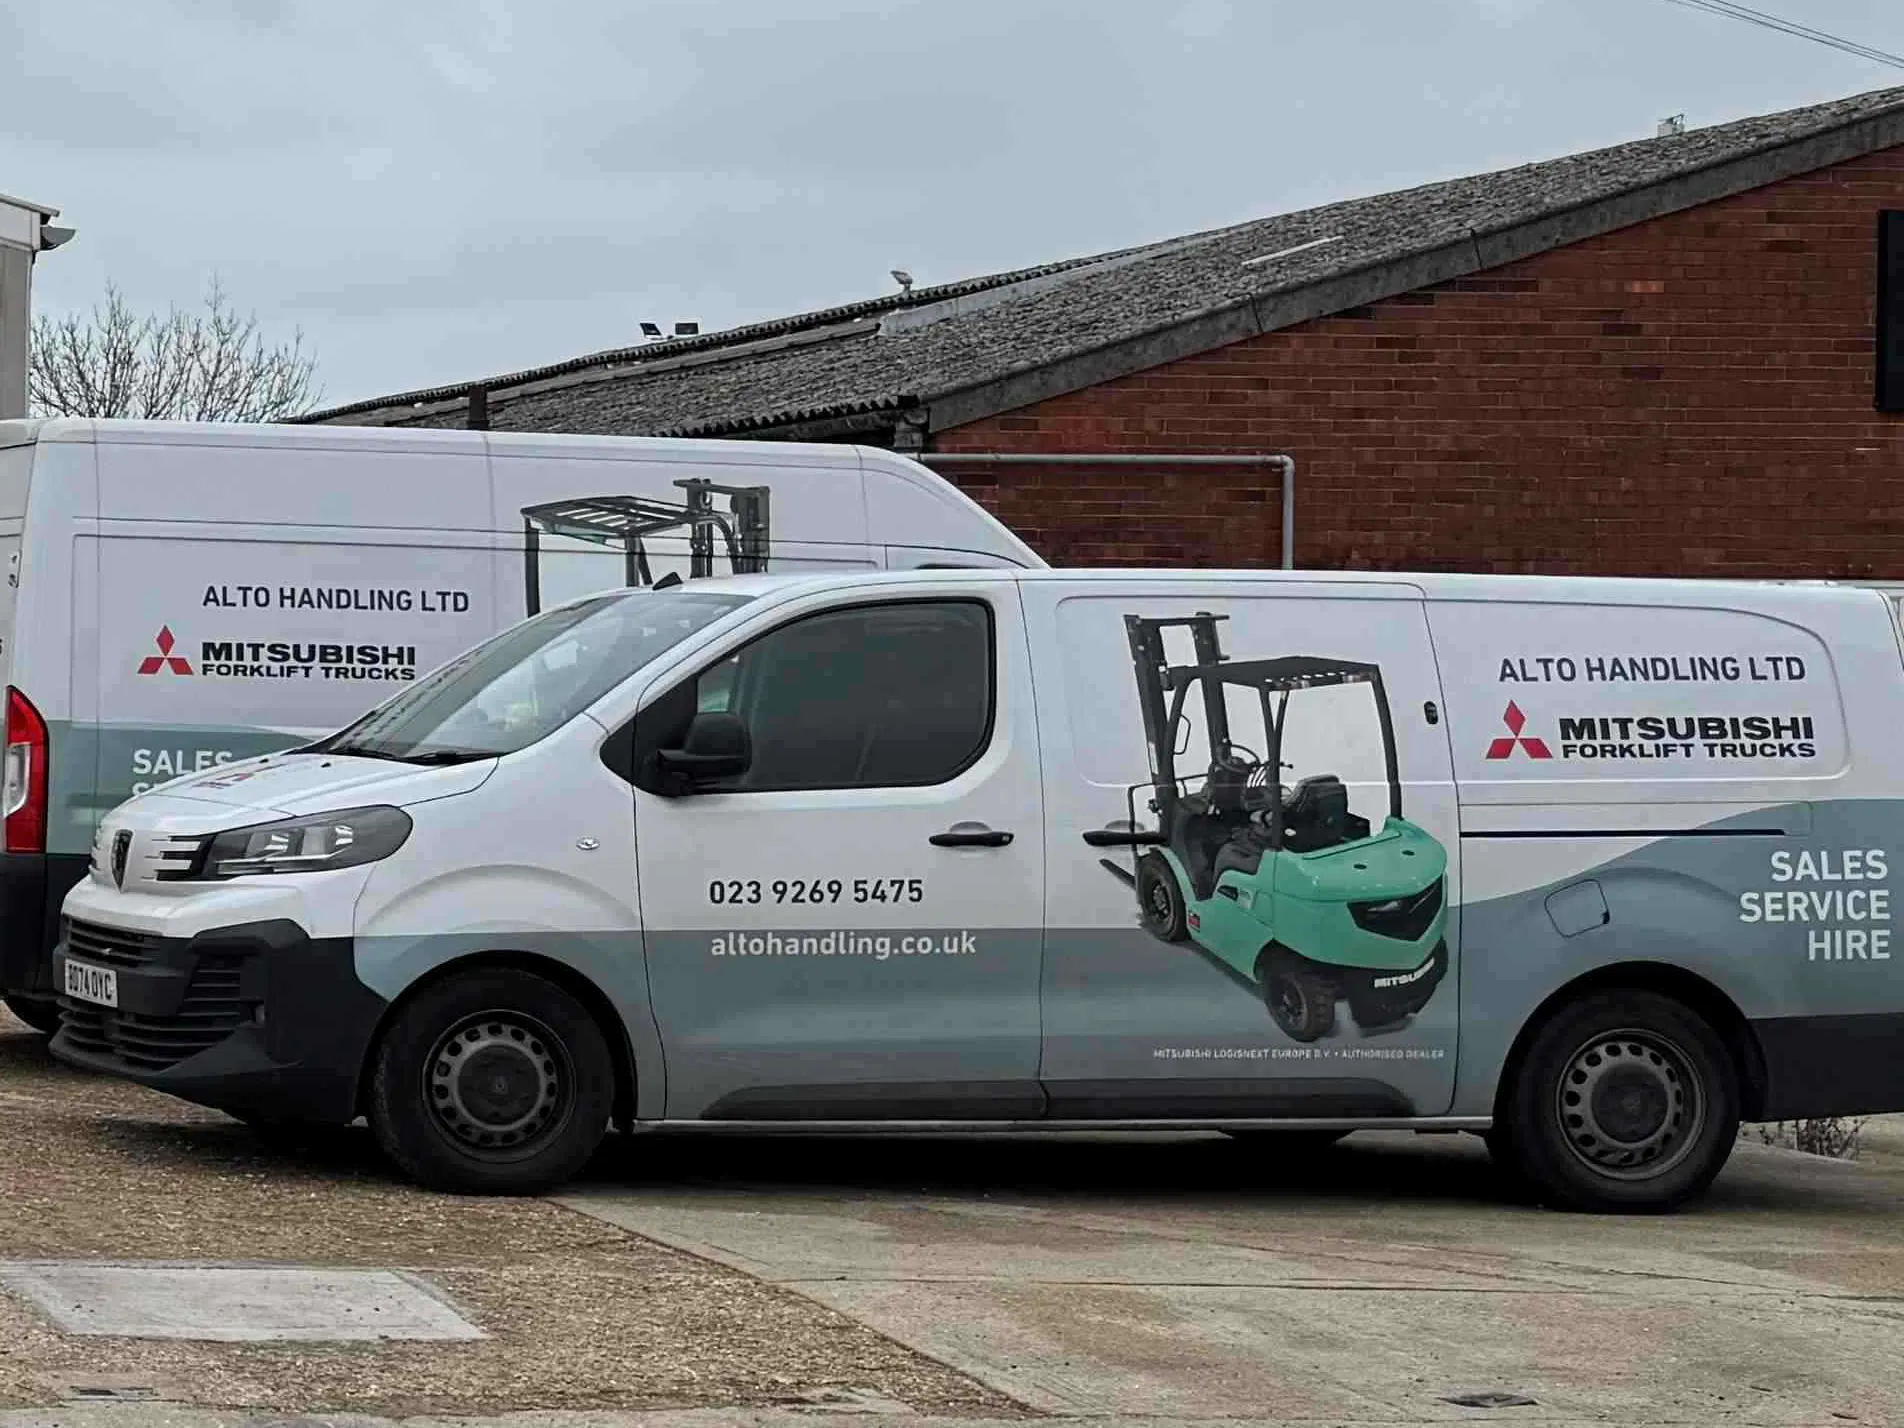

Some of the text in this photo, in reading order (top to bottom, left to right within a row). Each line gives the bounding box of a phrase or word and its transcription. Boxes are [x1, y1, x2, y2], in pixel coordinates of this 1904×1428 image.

[202, 585, 469, 613] ALTO HANDLING LTD
[201, 641, 416, 665] MITSUBISHI
[201, 663, 416, 681] FORKLIFT TRUCKS
[1498, 655, 1806, 683] ALTO HANDLING LTD
[1559, 717, 1815, 741] MITSUBISHI
[1562, 743, 1816, 759] FORKLIFT TRUCKS
[1770, 849, 1888, 881] SALES
[709, 879, 924, 904] 023 9269 5475
[1739, 890, 1891, 922] SERVICE
[711, 930, 976, 960] altohandling.co.uk
[1808, 929, 1891, 960] HIRE
